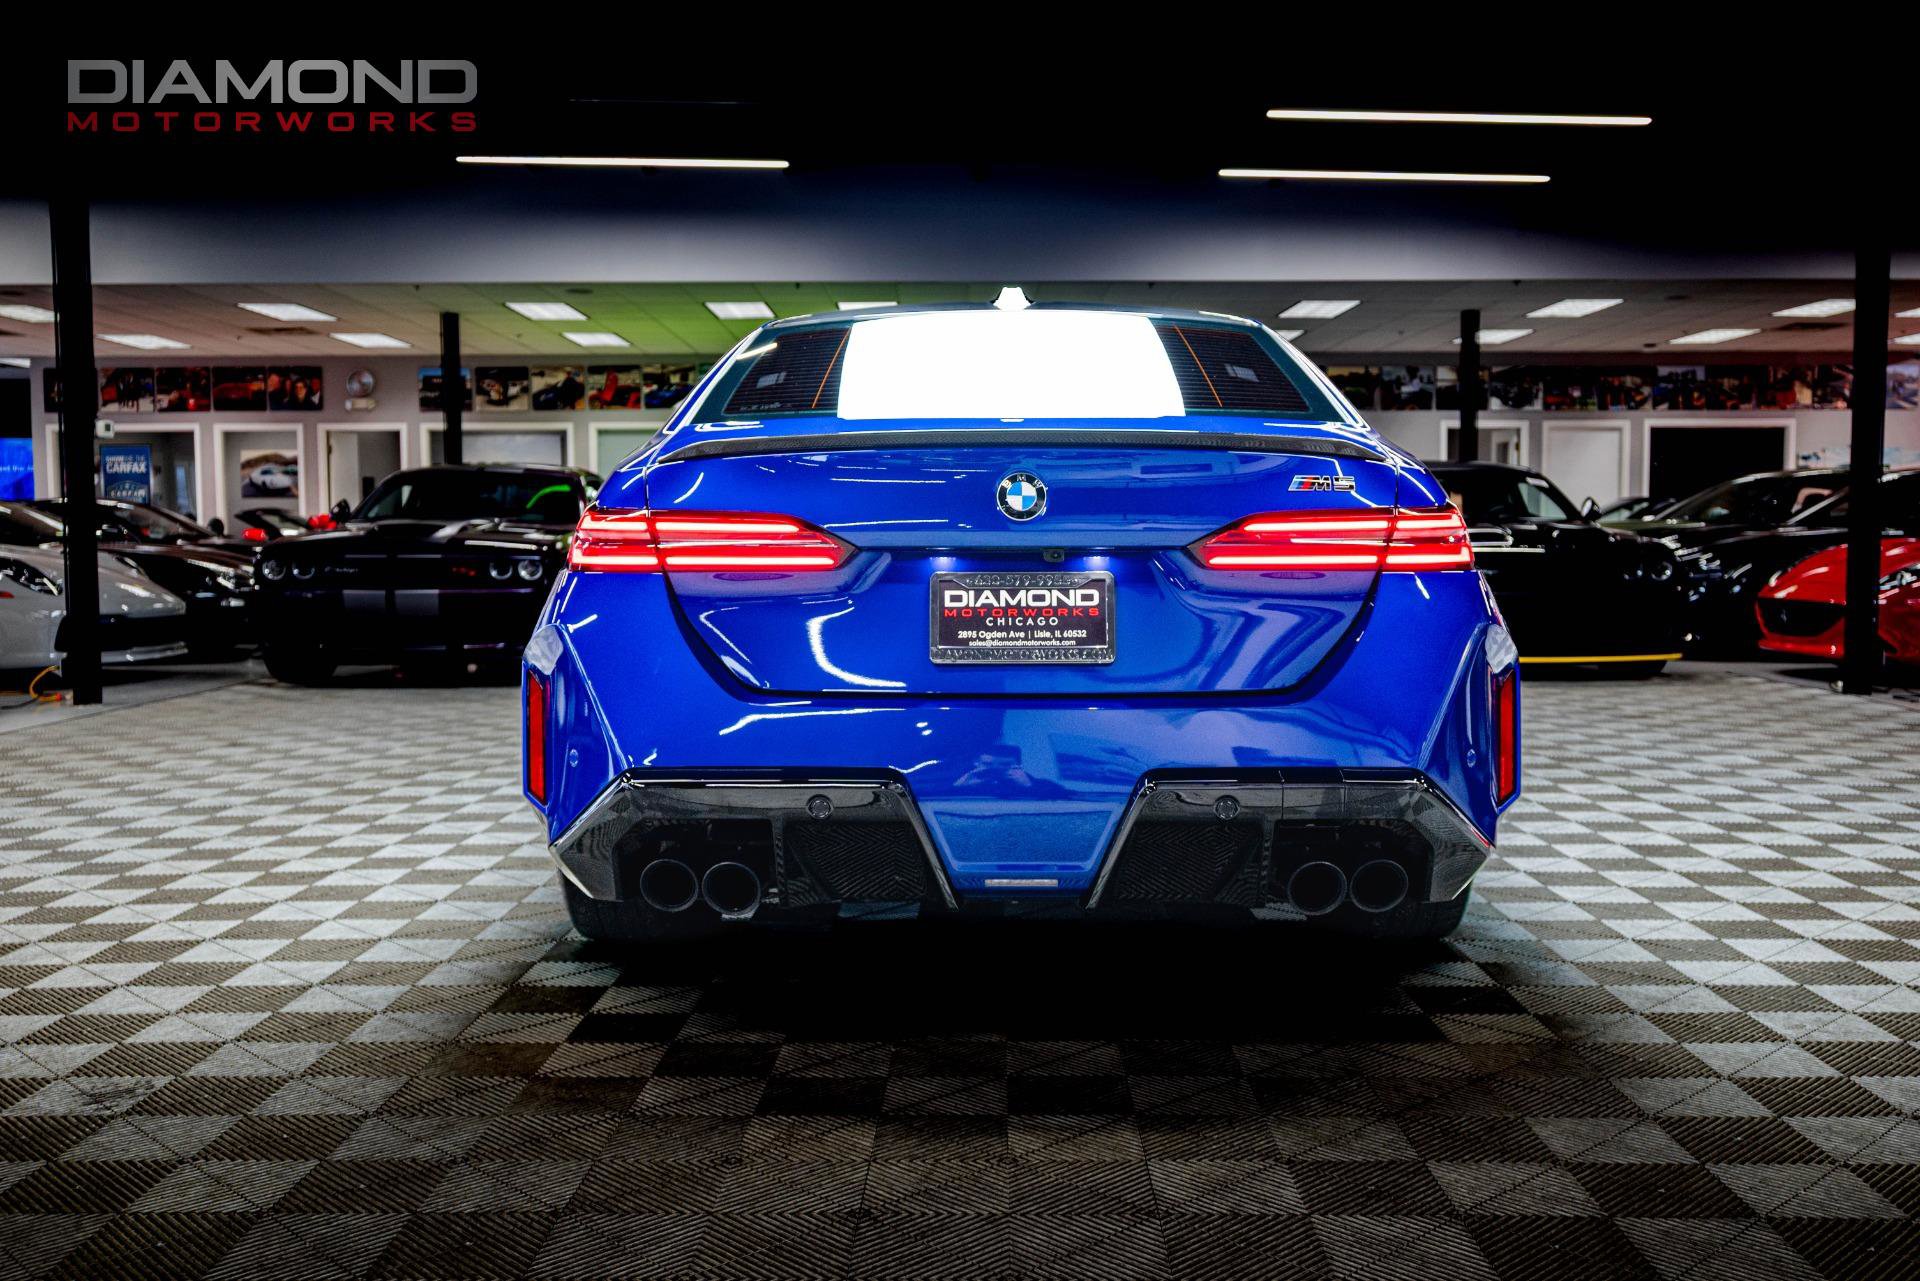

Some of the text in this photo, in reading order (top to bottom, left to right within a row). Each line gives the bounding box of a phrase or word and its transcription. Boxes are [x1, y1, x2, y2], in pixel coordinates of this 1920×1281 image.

[106, 461, 146, 474] CARFAX
[1001, 474, 1043, 489] BMW
[944, 589, 1100, 607] DIAMOND
[944, 608, 1099, 617] MOTORWORKS
[985, 617, 1059, 626] CHICAGO
[958, 630, 977, 639] 2895
[978, 630, 1007, 640] Ogden
[1008, 630, 1025, 639] Ave
[1034, 629, 1053, 639] Lisle,
[1055, 629, 1062, 638] IL
[1063, 629, 1087, 639] 60532
[968, 638, 1076, 647] sales@diamondmotorworks.com
